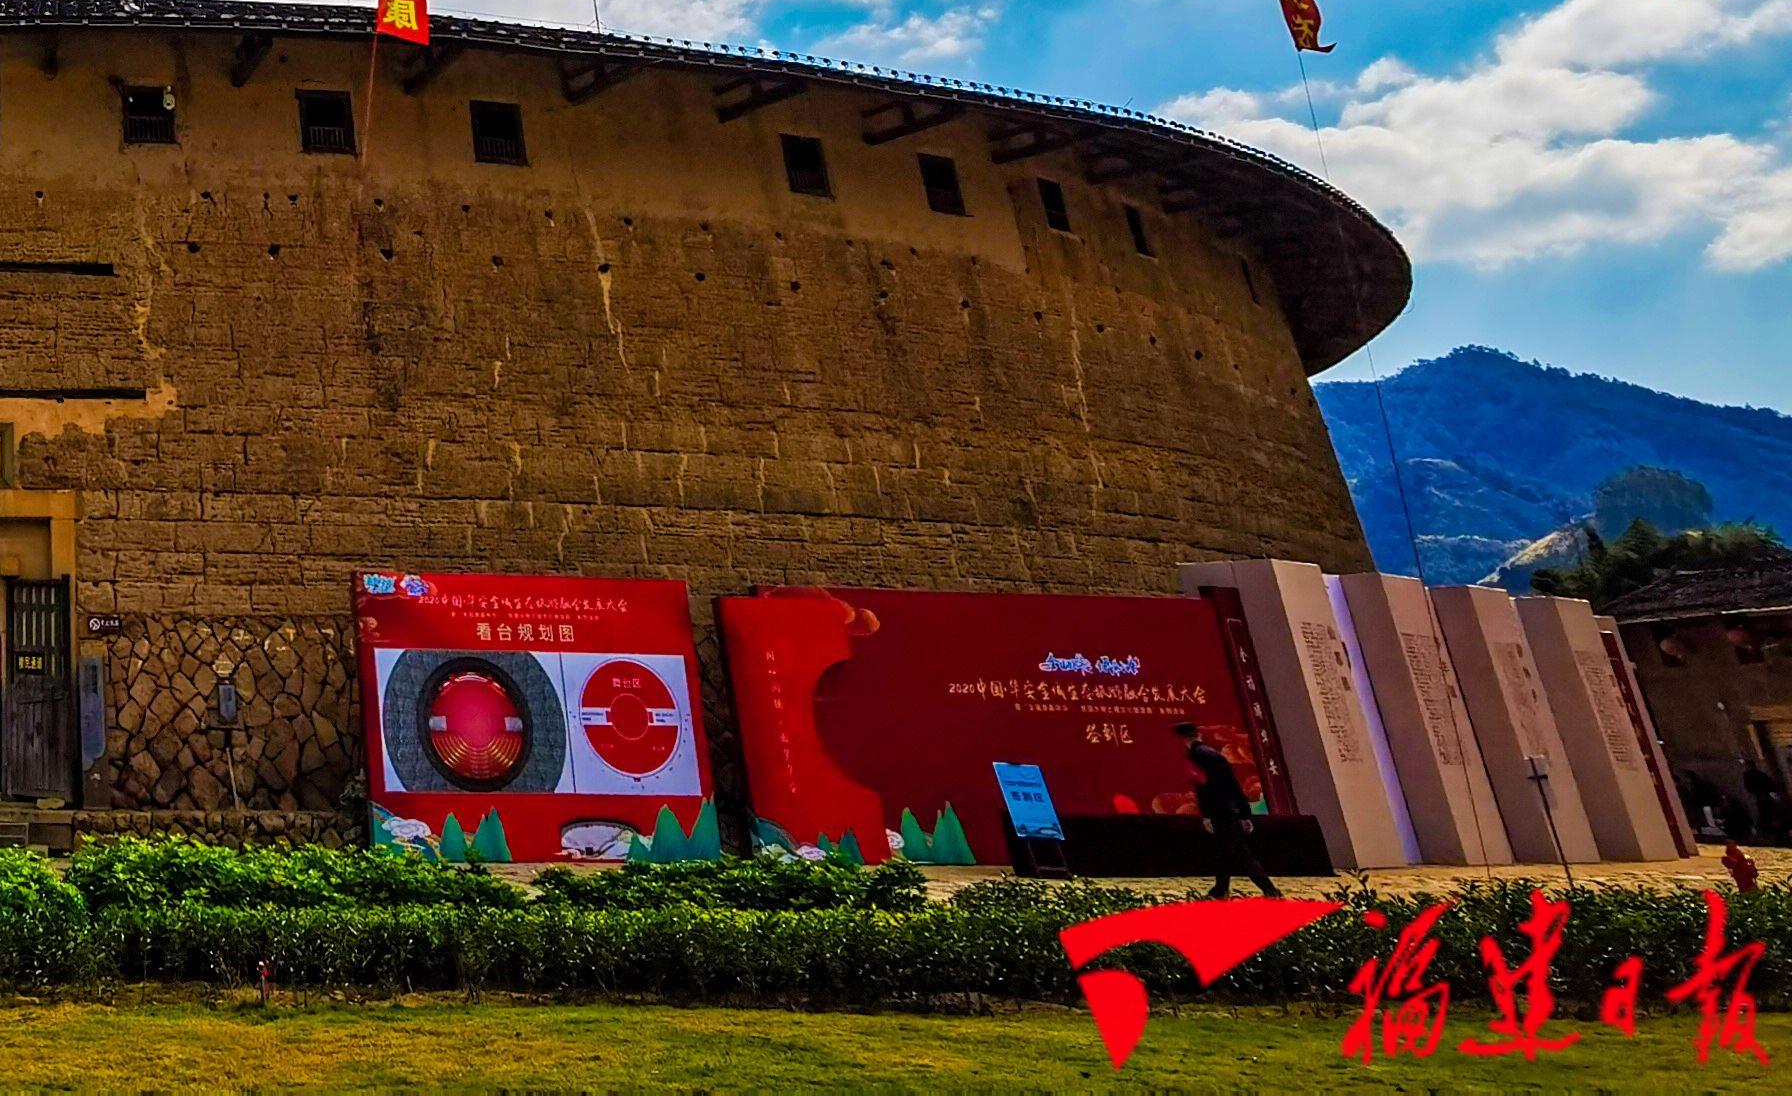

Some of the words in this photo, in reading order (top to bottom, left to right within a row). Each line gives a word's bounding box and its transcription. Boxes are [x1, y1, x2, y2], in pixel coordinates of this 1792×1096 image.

[476, 623, 575, 643] 看台规划图
